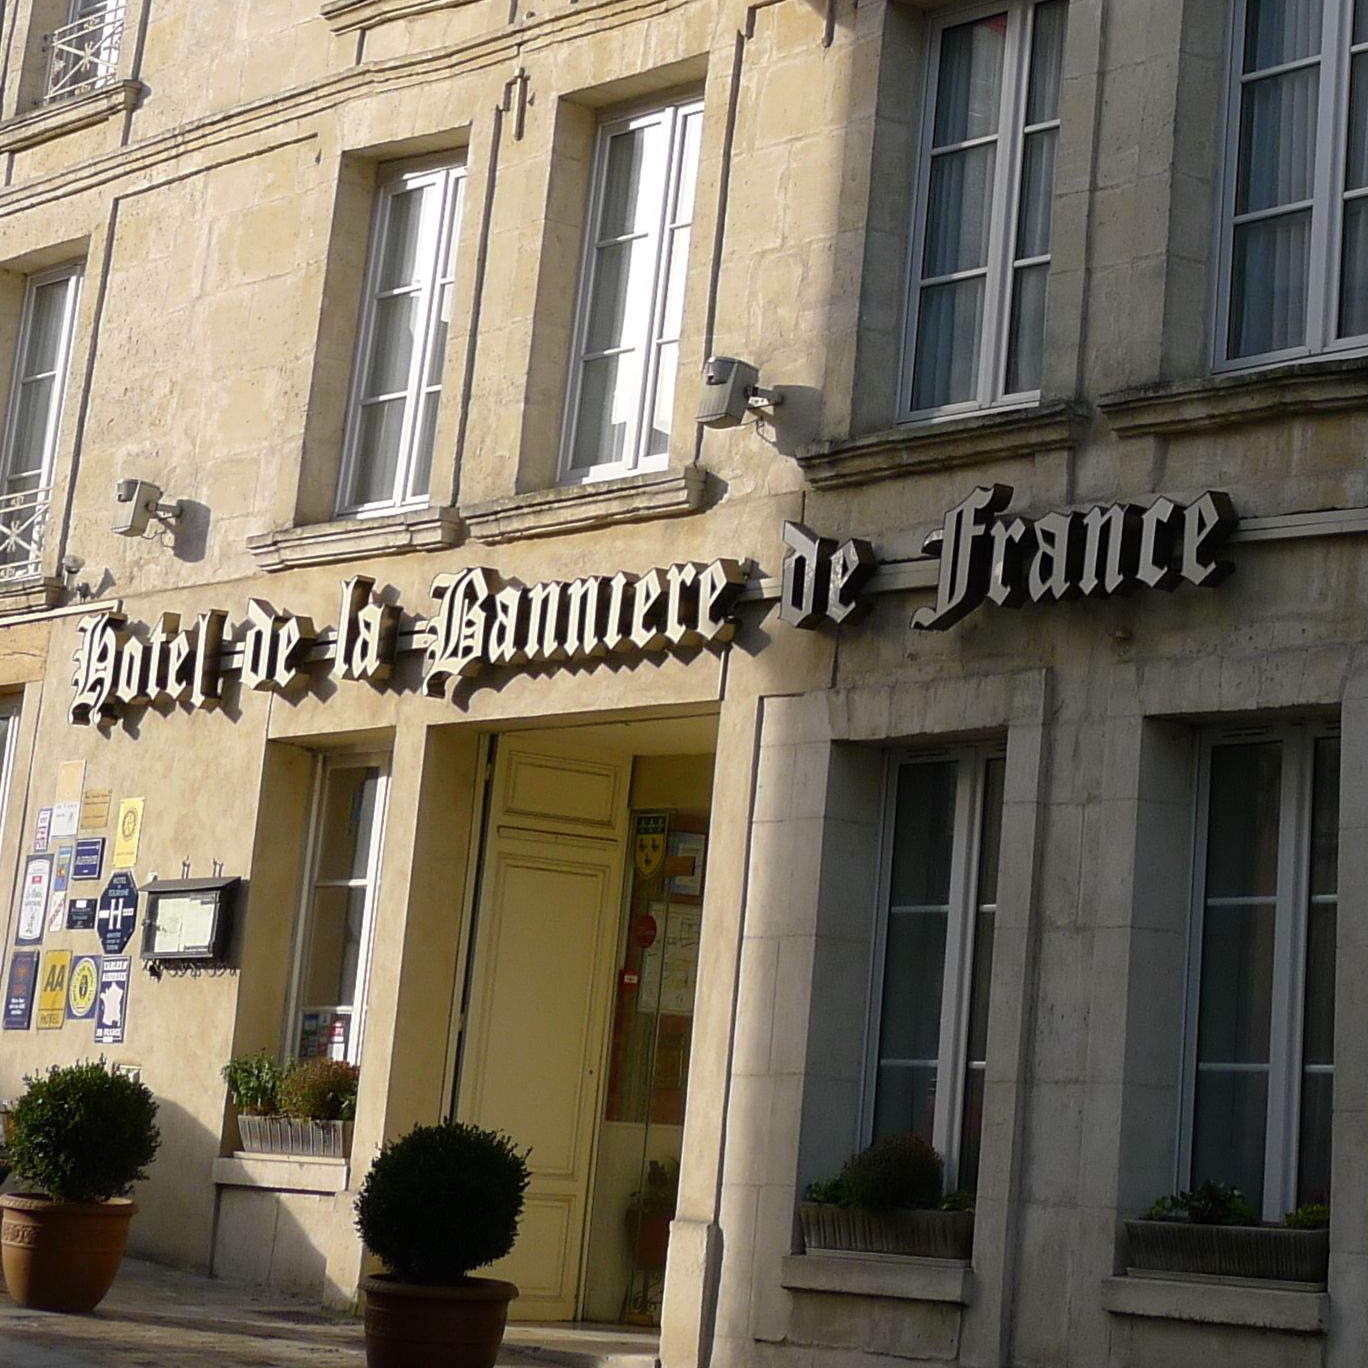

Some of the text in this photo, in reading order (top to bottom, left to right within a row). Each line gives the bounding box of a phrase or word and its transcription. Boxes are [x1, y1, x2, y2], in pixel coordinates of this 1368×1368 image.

[68, 608, 224, 725] Hotel
[239, 598, 305, 689] de
[333, 575, 392, 680] la
[779, 521, 864, 629] de
[908, 483, 1230, 632] France
[43, 964, 66, 992] AA
